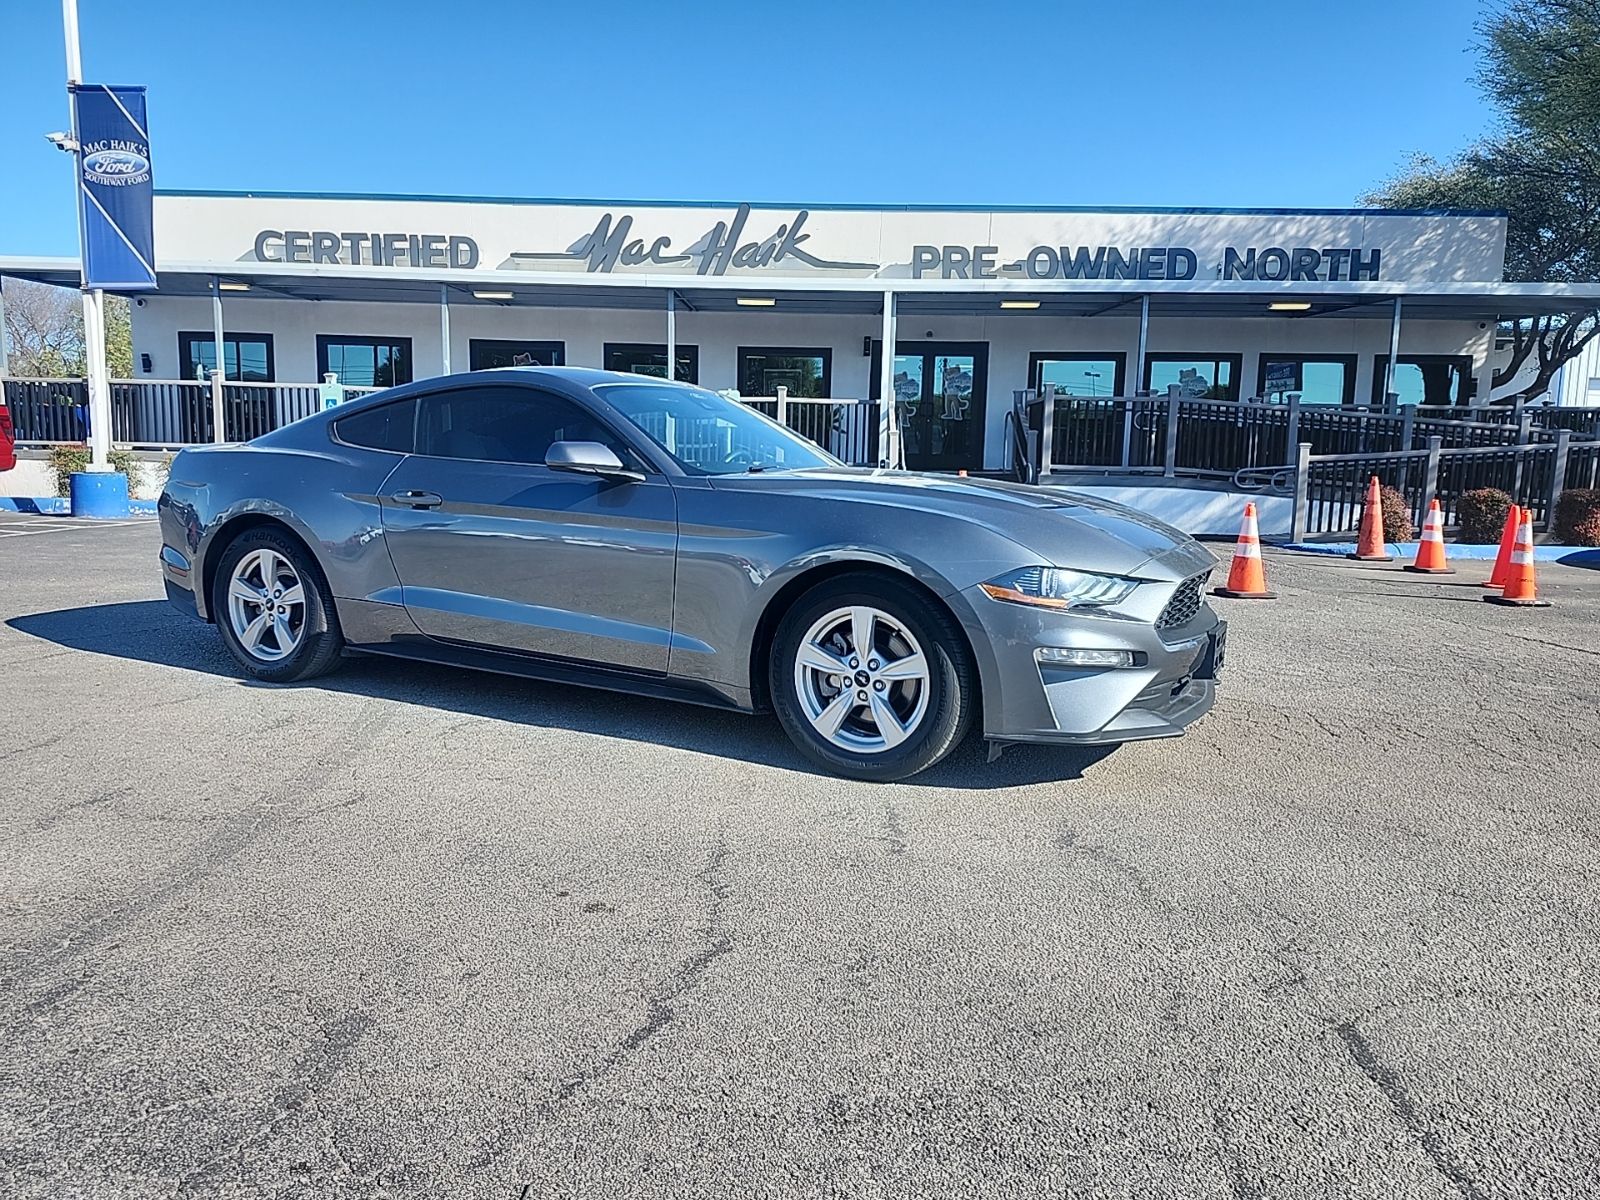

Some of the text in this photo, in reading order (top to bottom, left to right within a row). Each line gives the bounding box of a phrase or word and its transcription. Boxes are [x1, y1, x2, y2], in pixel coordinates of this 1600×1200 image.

[83, 140, 148, 157] MAC HAIK'S
[95, 155, 136, 173] Ford
[84, 172, 150, 186] SOUTHWAY FORD
[254, 230, 480, 269] CERTIFIED
[510, 202, 881, 275] Mac Haik
[1223, 247, 1382, 281] NORTH
